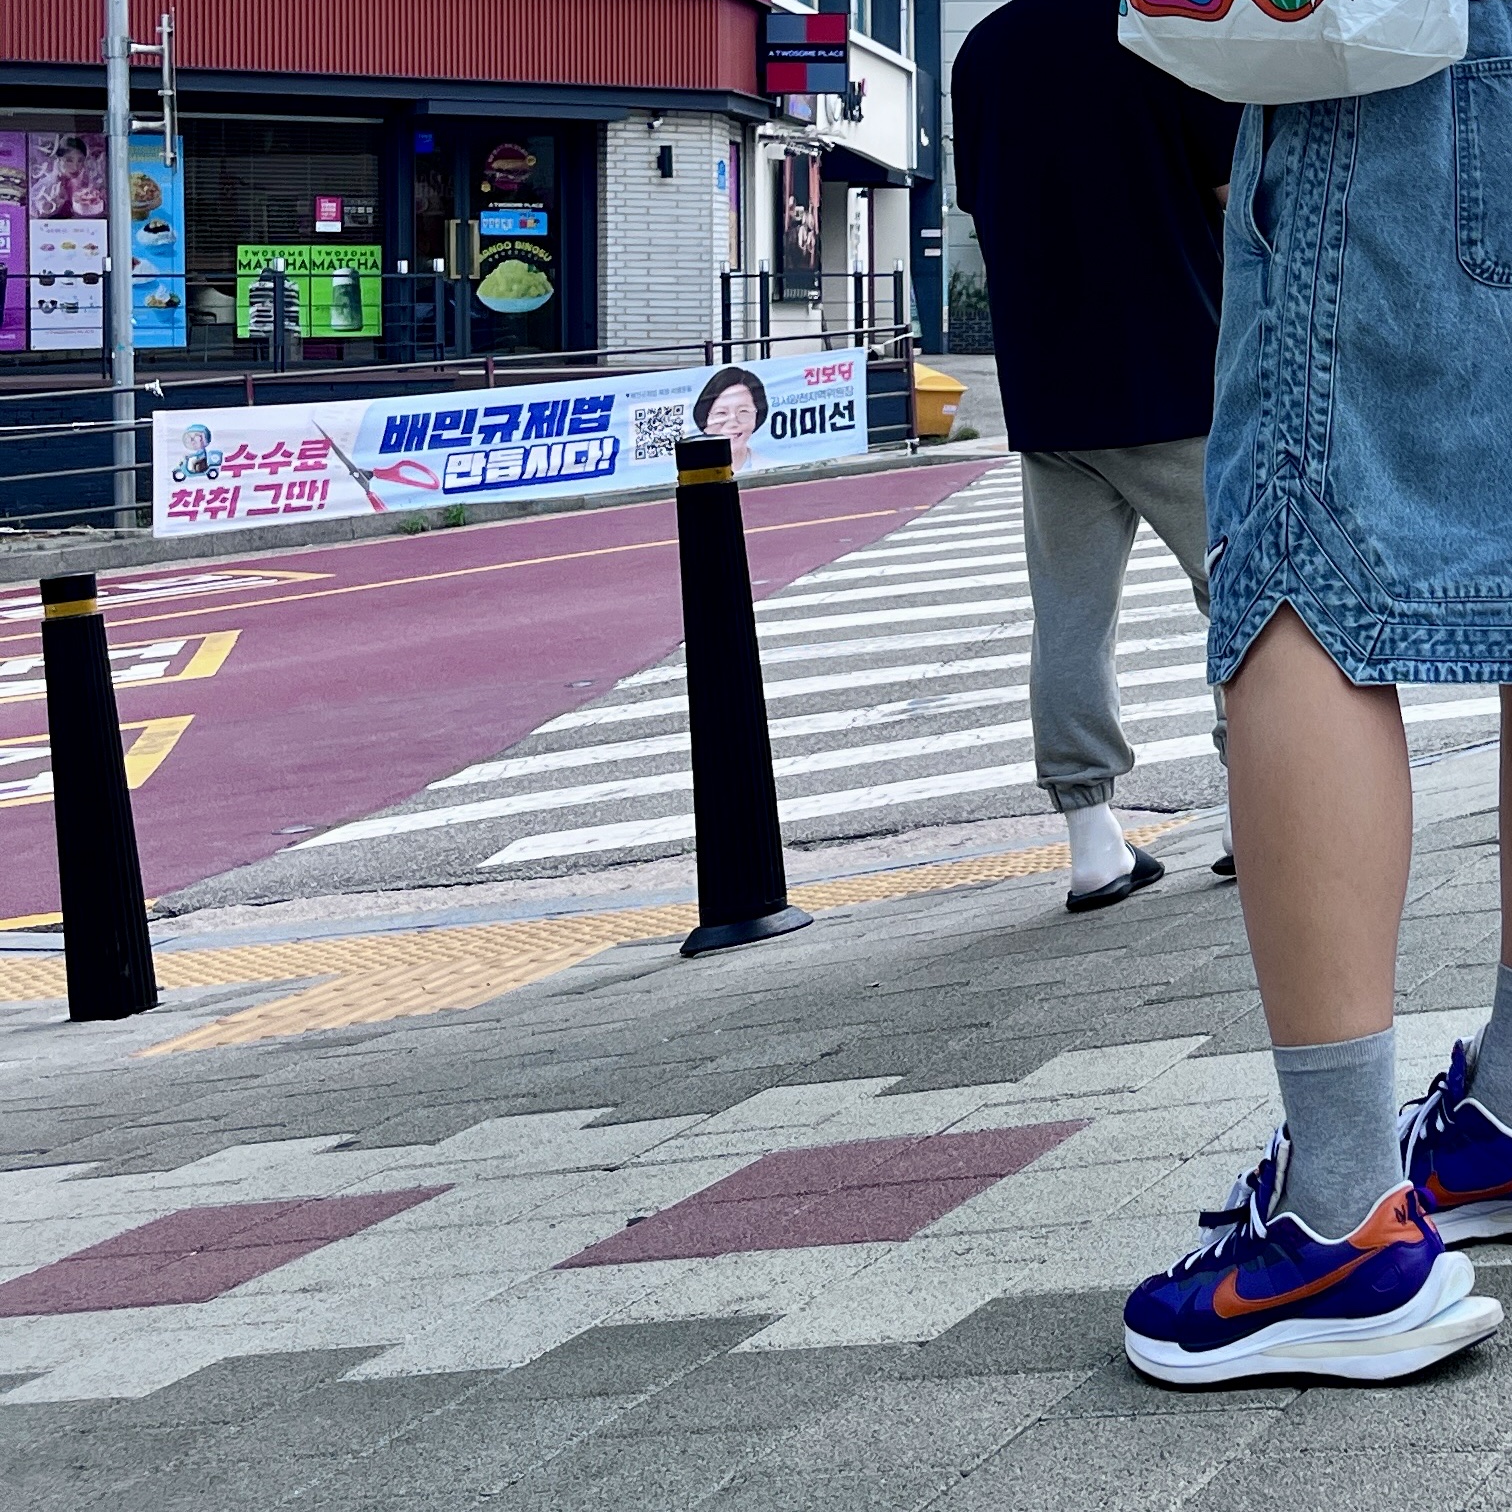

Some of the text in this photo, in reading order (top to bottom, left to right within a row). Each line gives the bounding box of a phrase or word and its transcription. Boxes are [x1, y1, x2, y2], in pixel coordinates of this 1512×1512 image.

[239, 258, 308, 270] MATHA
[312, 258, 380, 270] MATCHA
[804, 361, 855, 386] 진보당
[378, 394, 616, 454] 배민규제법
[770, 400, 856, 439] 이미선
[220, 437, 333, 478] 수수료
[442, 436, 619, 493] 만듭시다!
[167, 478, 331, 522] 착취 그만!
